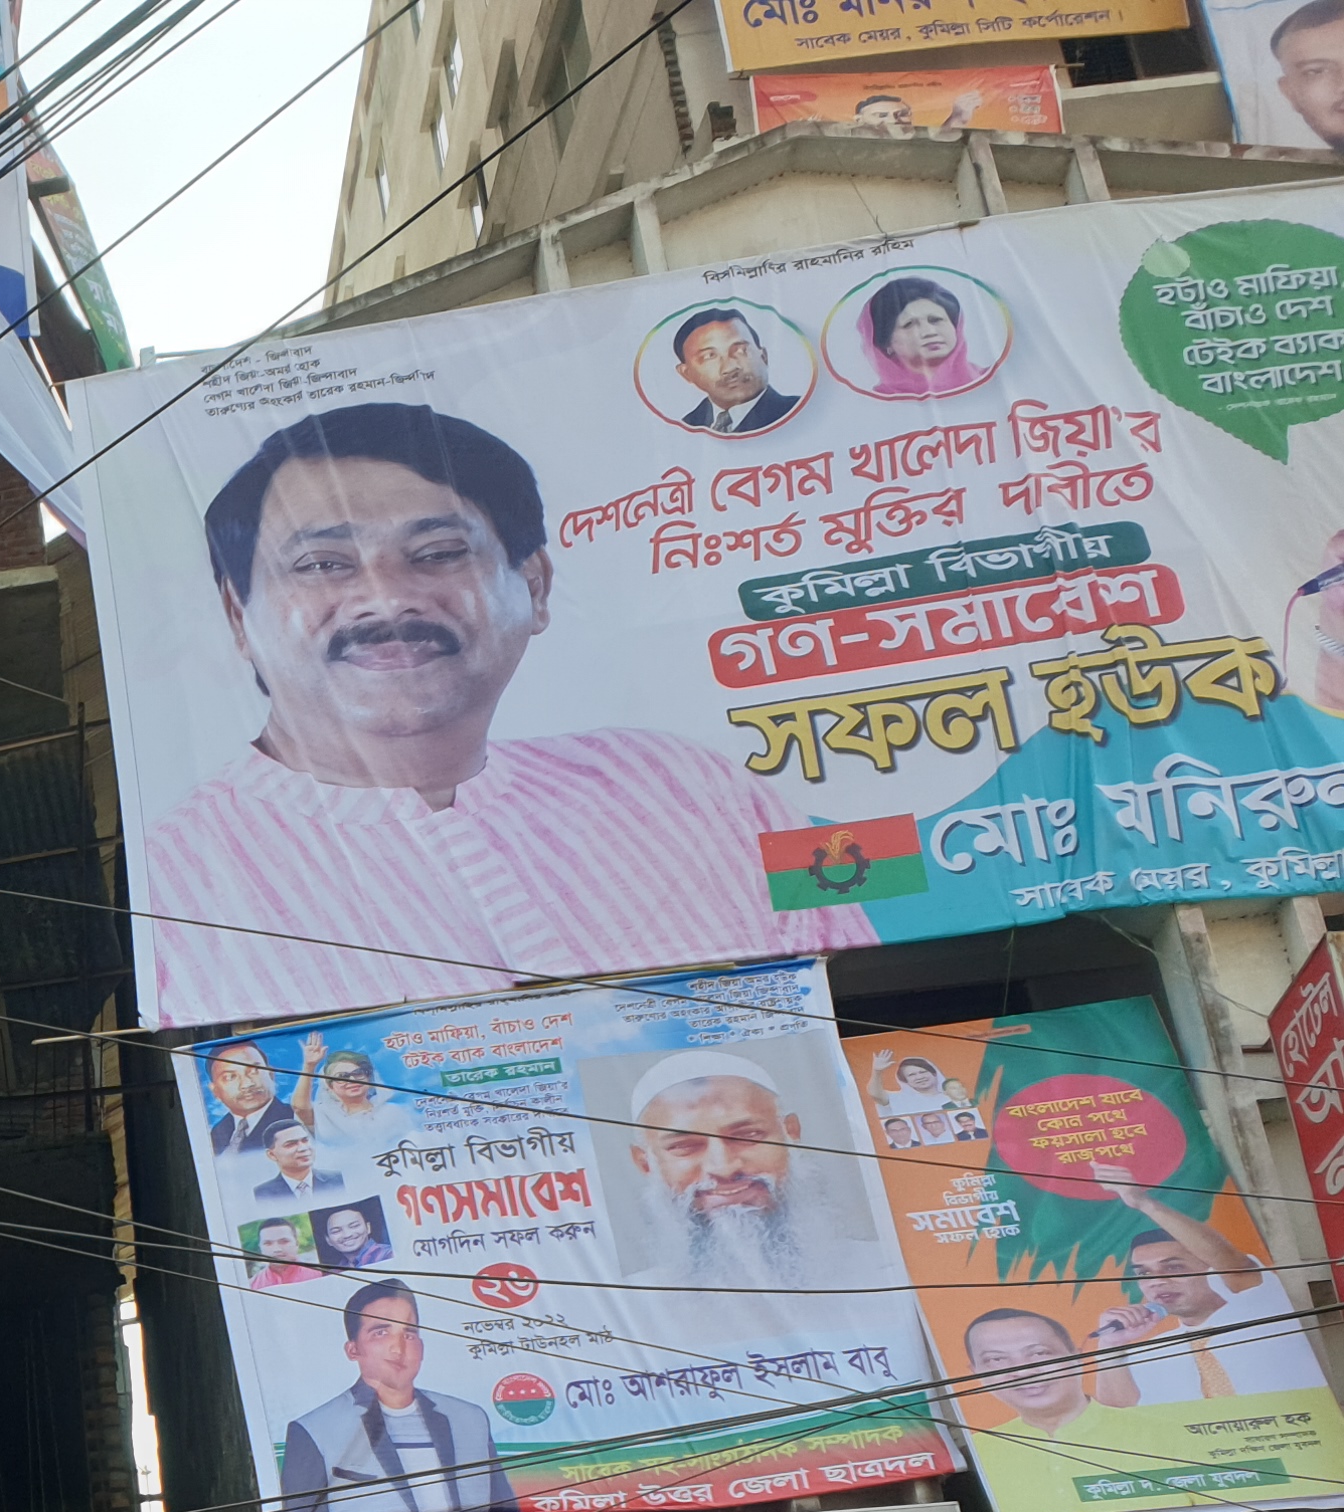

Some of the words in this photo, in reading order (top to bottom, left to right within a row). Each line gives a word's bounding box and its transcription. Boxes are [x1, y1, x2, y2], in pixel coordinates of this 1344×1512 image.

[1154, 276, 1228, 308] হটাও
[1234, 262, 1340, 300] মাফিয়া
[1181, 297, 1267, 333] বাঁচাও
[1274, 290, 1334, 322] দেশ
[1183, 332, 1267, 369] টেইক
[1200, 360, 1342, 397] বাংলাদেশ
[559, 465, 698, 550] দেশনেত্রী
[710, 451, 835, 514] বেগম
[849, 417, 998, 484] খালেদা
[649, 512, 809, 576] নিঃশর্ত
[821, 484, 968, 555] মুক্তির
[998, 462, 1155, 519] দাবীতে
[750, 561, 913, 614] কুমিল্লা
[925, 526, 1112, 583] বিভাগীয়
[718, 566, 1163, 679] গণ-সমাবেশ
[727, 666, 1017, 781] সফল
[1031, 624, 1282, 746] হউক
[929, 793, 1079, 873] মোঃ
[1006, 1093, 1096, 1121] বাংলাদেশ
[1098, 1088, 1145, 1110] যাবে
[1037, 1114, 1084, 1133] কোন
[1088, 1106, 1127, 1126] পথে
[372, 1139, 459, 1181] কুমিল্লা
[465, 1125, 577, 1170] বিভাগীয়
[1029, 1130, 1108, 1153] ফয়সালা
[1111, 1122, 1149, 1143] হবে
[397, 1166, 594, 1228] গণসমাবেশ
[907, 1199, 1021, 1233] সমাবেশ
[410, 1230, 486, 1261] যোগদিন
[492, 1224, 545, 1251] সফল
[548, 1219, 597, 1246] করুন
[476, 1269, 538, 1304] ২৬
[564, 1372, 616, 1412] মোঃ
[621, 1358, 743, 1410] আশরাফুল
[752, 1346, 839, 1388] ইসলাম
[846, 1344, 898, 1383] বাবু
